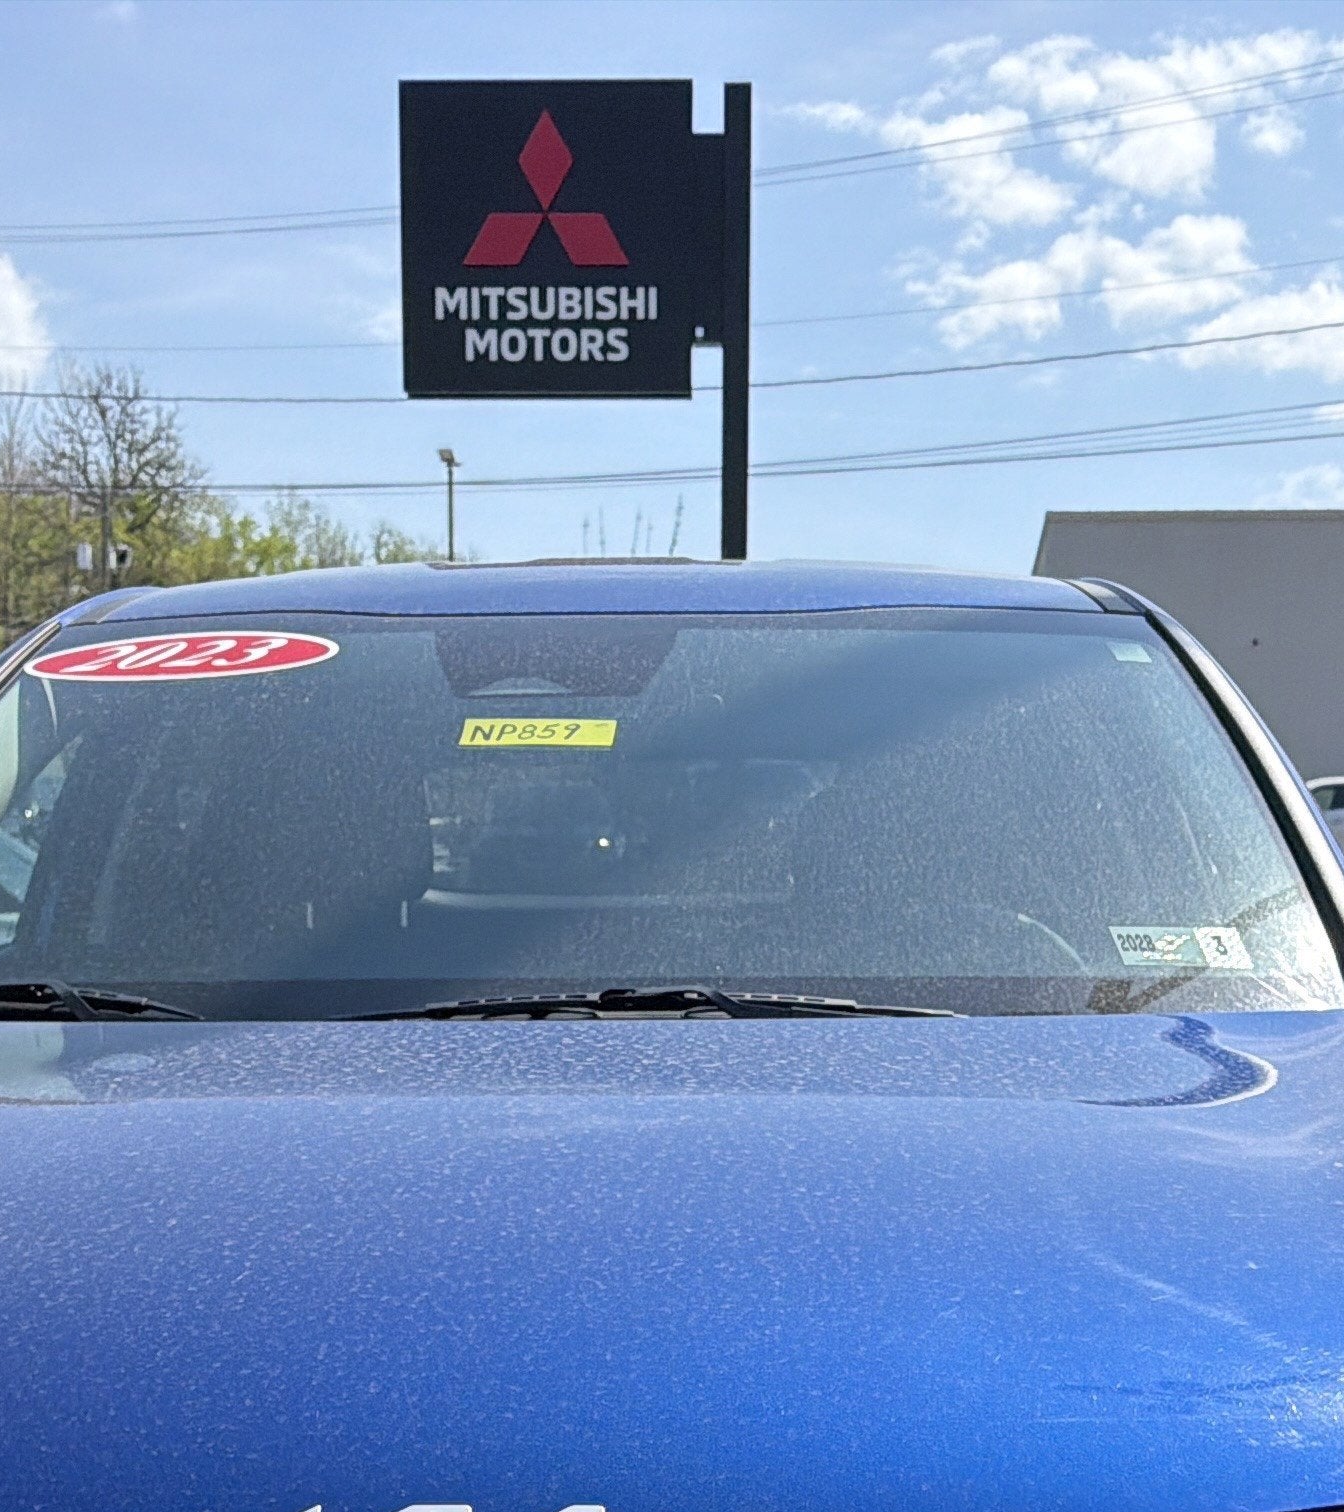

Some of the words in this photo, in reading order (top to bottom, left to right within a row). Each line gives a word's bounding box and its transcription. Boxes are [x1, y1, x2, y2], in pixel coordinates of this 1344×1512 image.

[434, 286, 657, 320] MITSUBISHI
[464, 327, 630, 362] MOTORS
[59, 638, 289, 673] 2023
[469, 722, 581, 742] NP859
[1116, 933, 1156, 952] 2028
